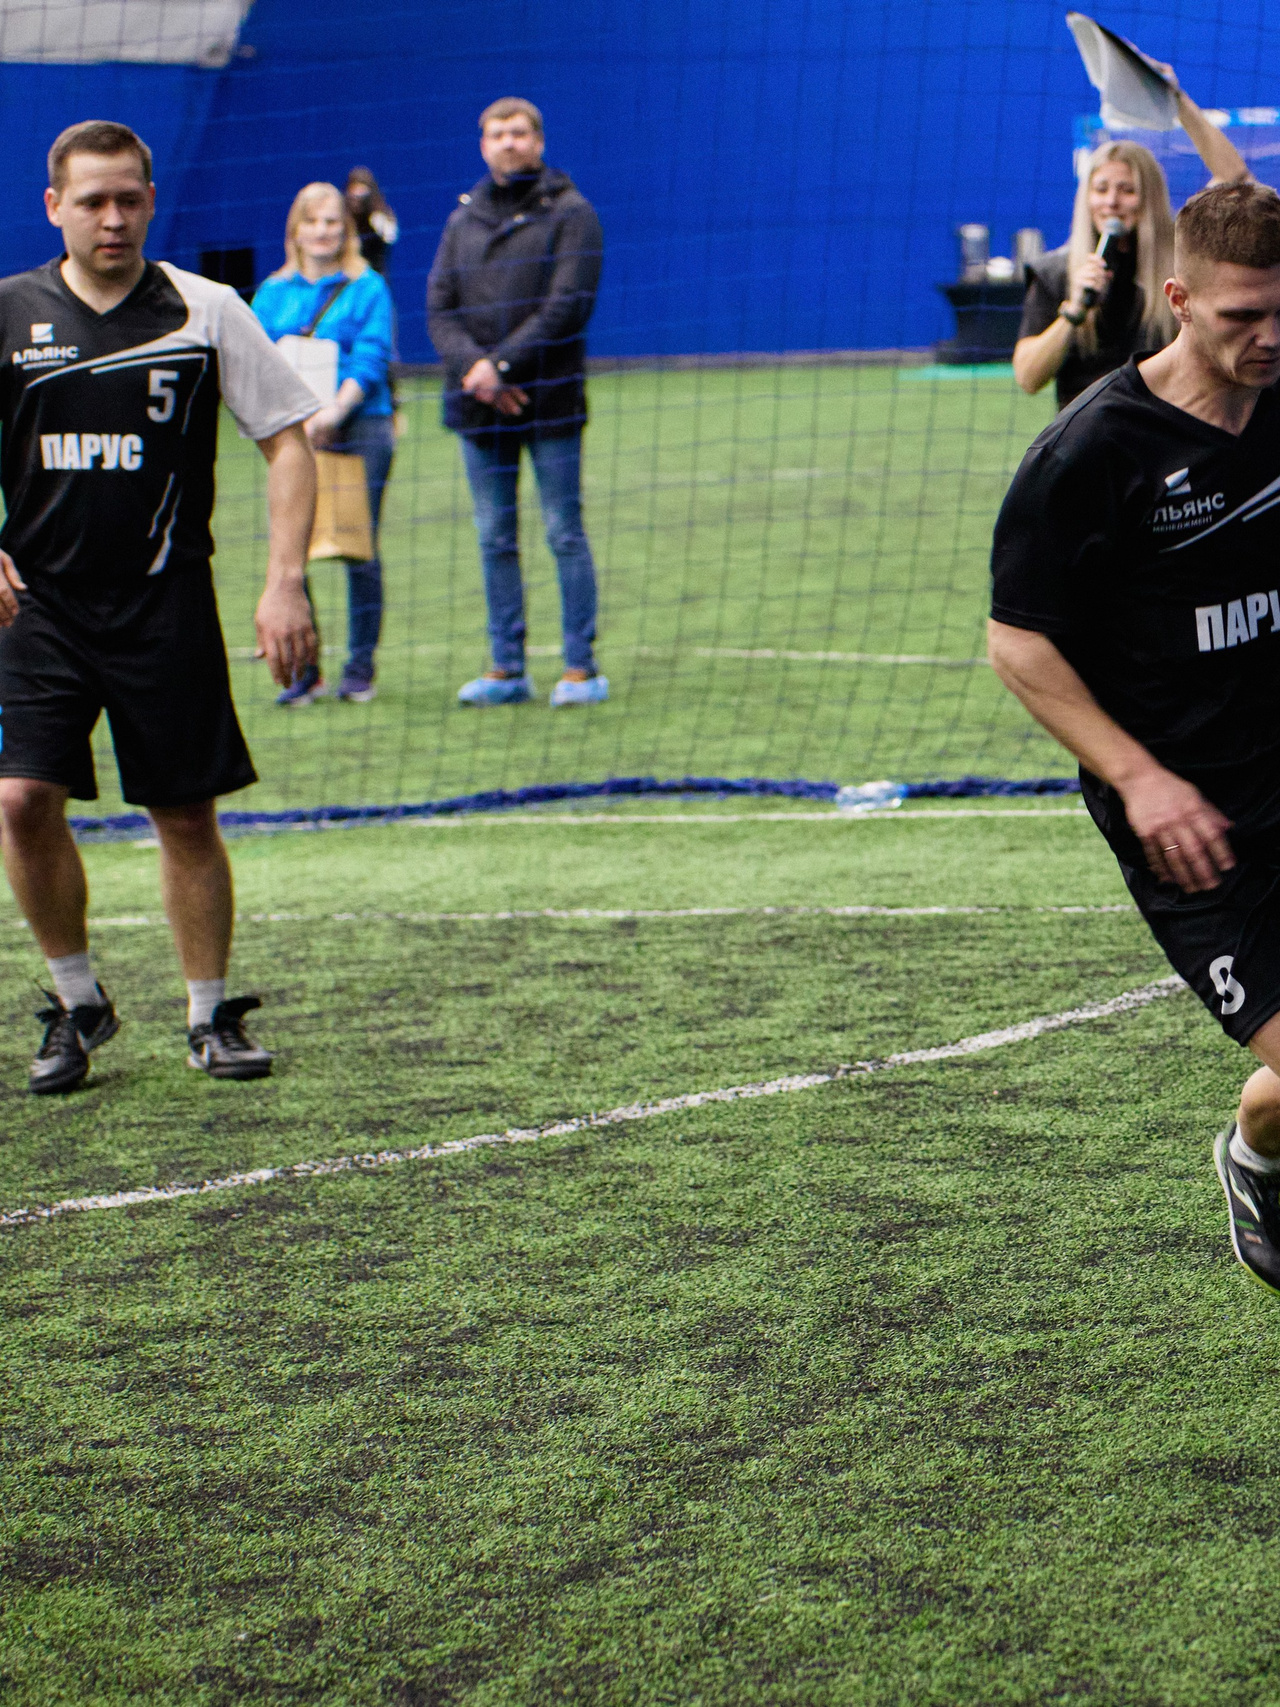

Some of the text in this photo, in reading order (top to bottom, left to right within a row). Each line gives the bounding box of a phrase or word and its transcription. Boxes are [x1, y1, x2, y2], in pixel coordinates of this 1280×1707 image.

[147, 369, 180, 423] 5
[40, 432, 144, 471] ПАРУС
[1149, 491, 1226, 524] ЛЬЯНС
